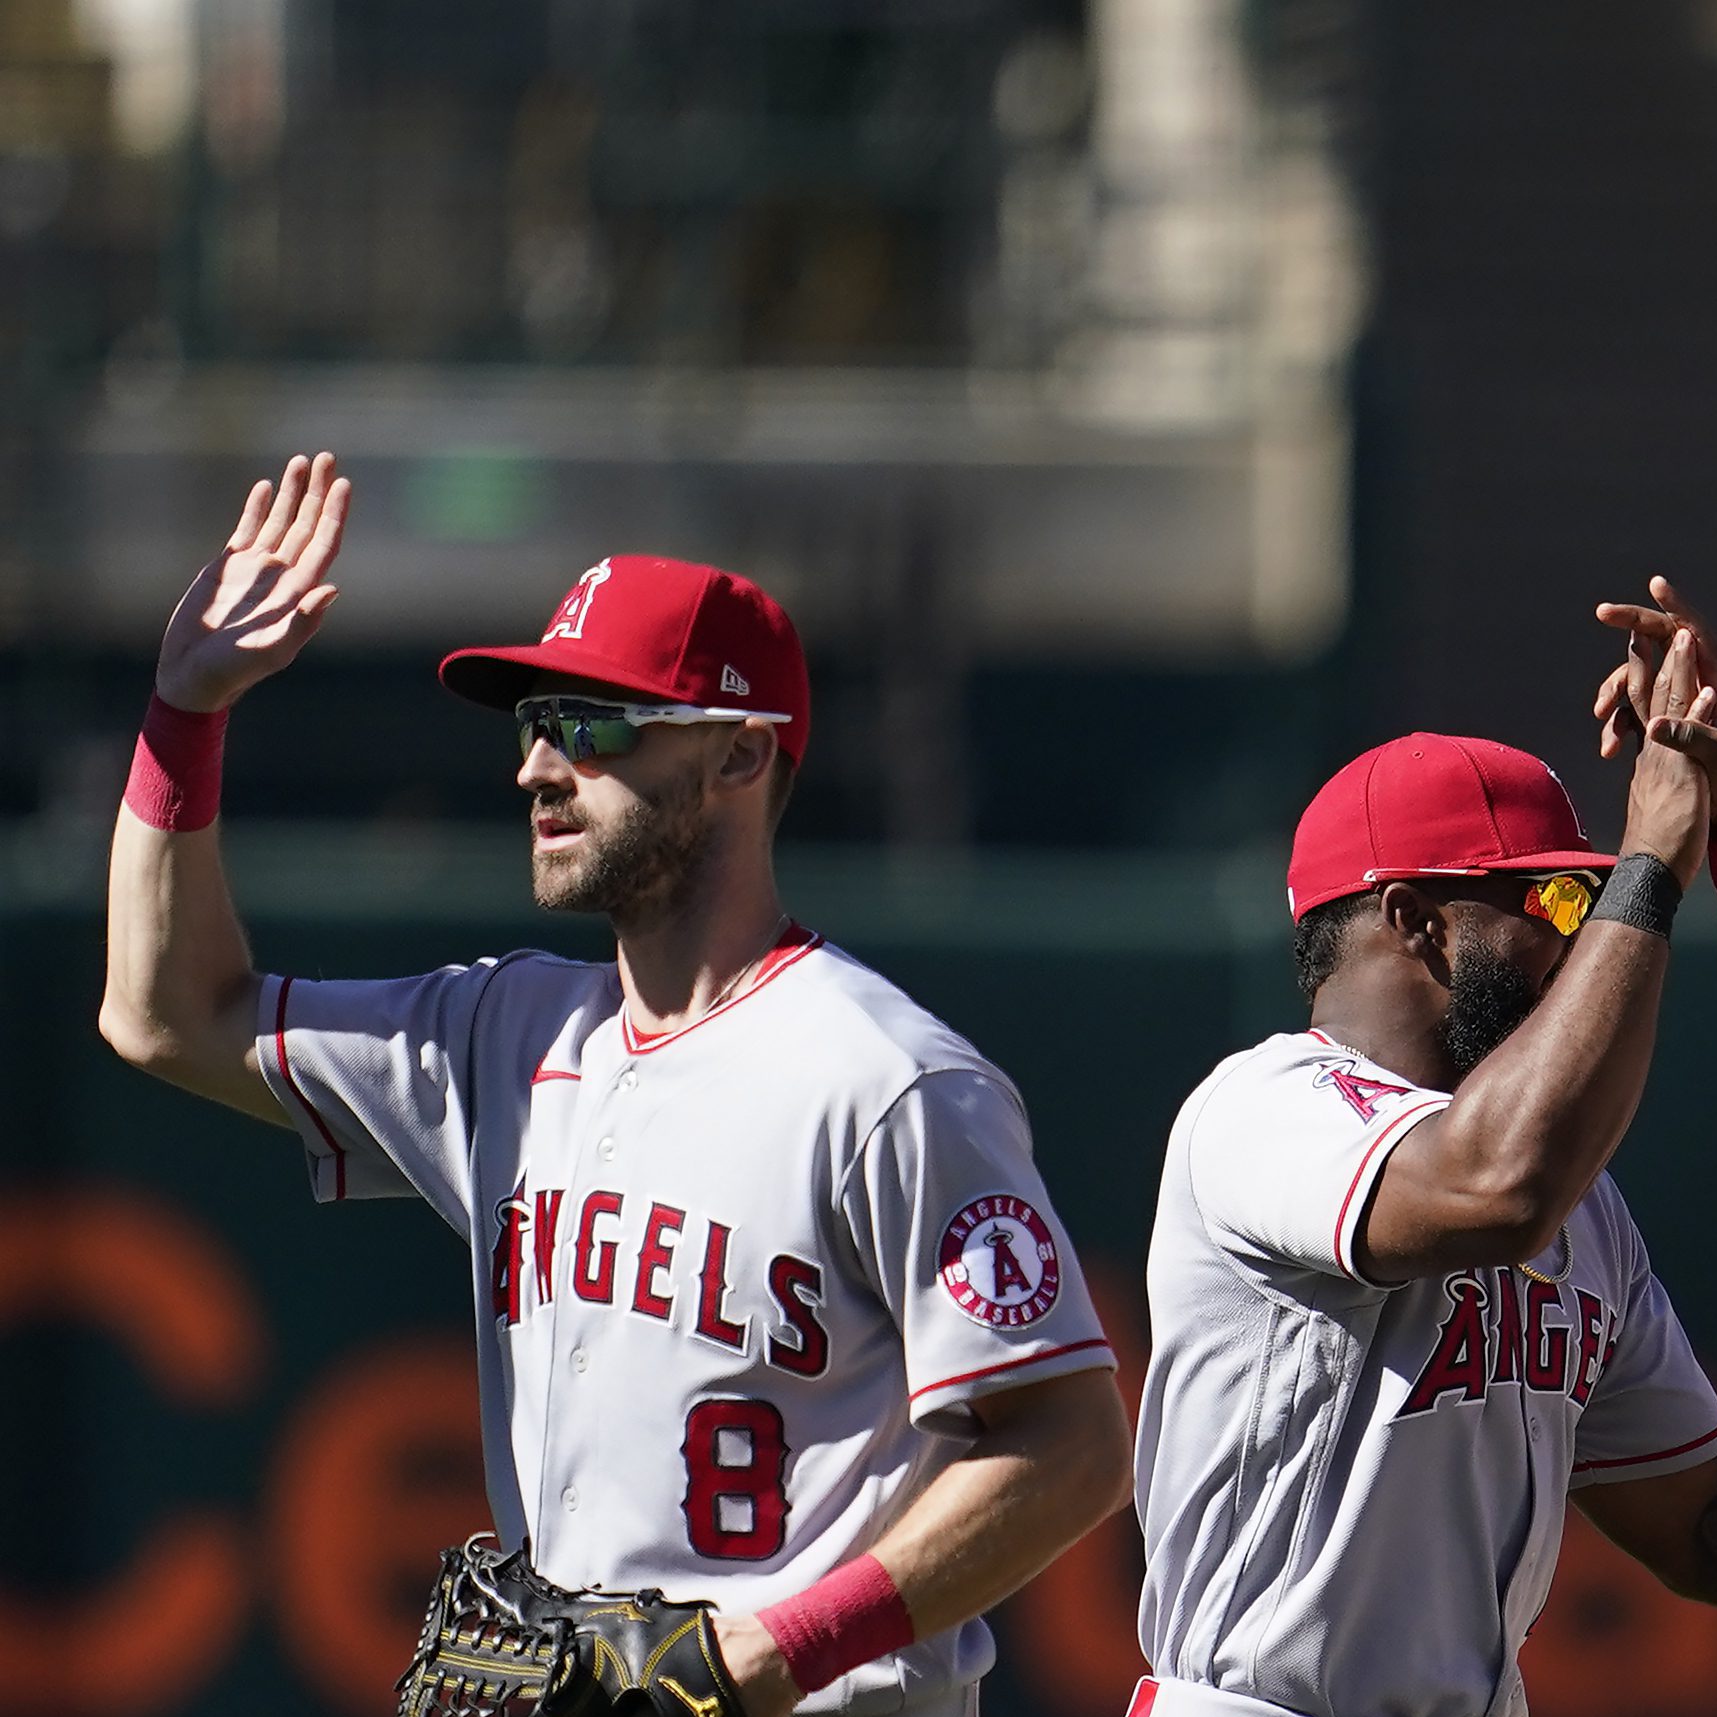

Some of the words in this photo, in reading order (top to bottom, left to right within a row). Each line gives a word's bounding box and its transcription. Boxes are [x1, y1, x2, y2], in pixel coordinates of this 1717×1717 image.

[1313, 1060, 1418, 1125] A
[951, 1199, 1033, 1240] ANGELS
[492, 1170, 832, 1381] ANGELS
[983, 1221, 1032, 1298] A
[957, 1275, 1058, 1326] BASEBALL
[679, 1398, 792, 1561] 8
